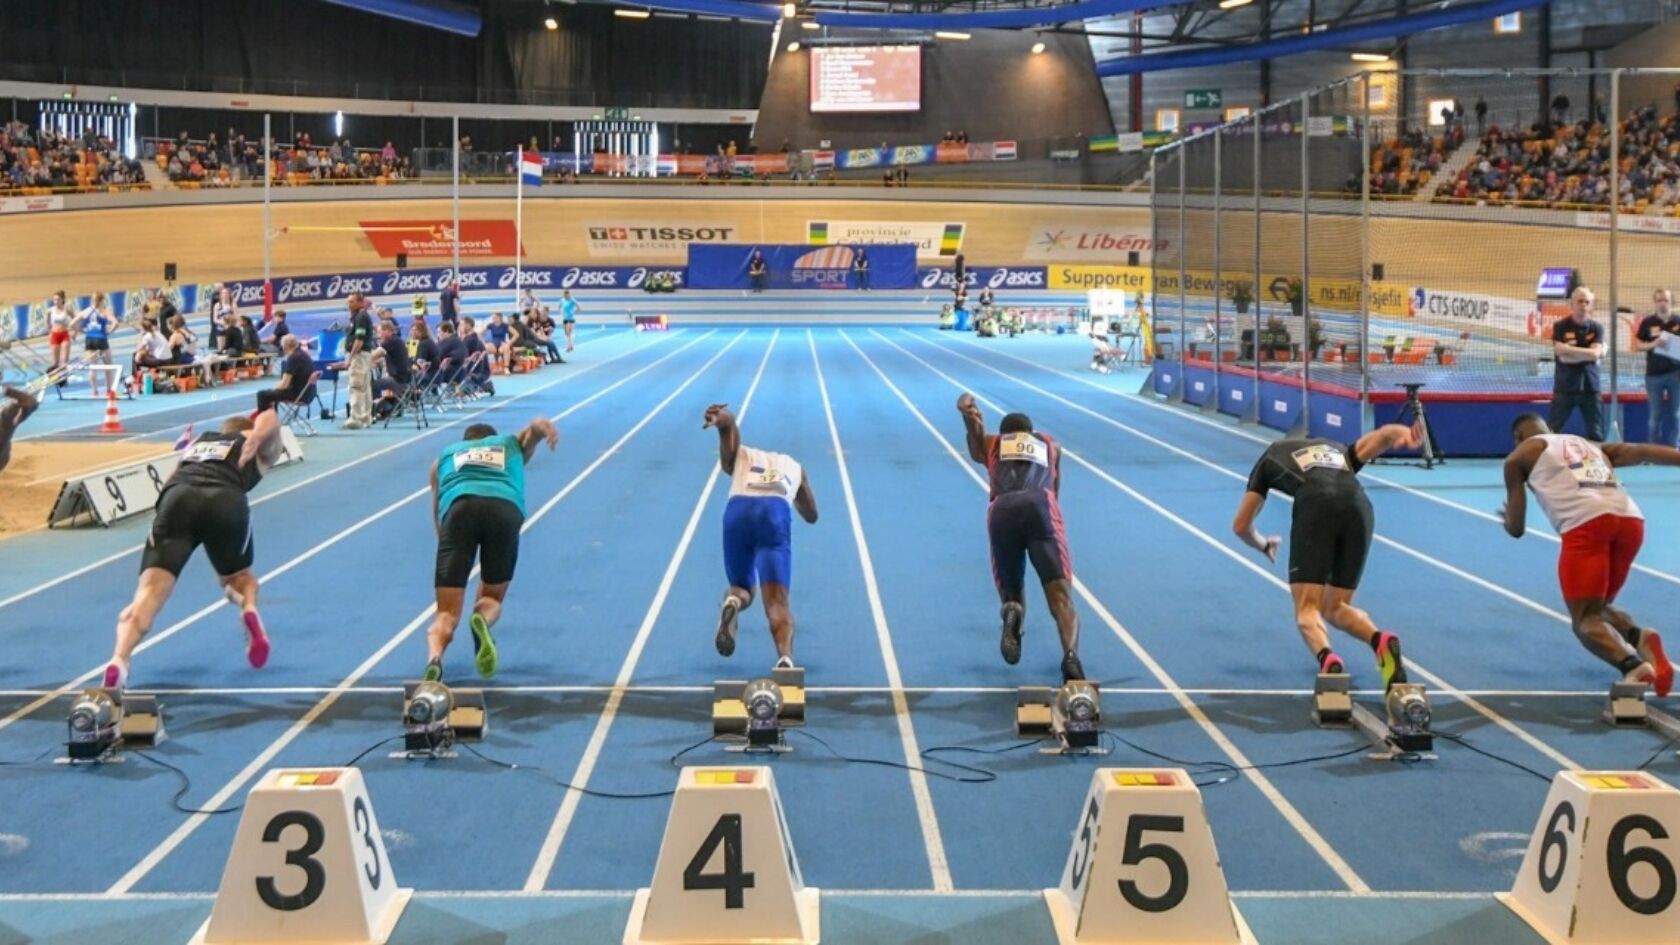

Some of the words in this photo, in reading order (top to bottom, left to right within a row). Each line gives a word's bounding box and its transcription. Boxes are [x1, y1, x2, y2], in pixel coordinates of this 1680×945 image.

[630, 228, 732, 240] TISSOT
[847, 227, 911, 237] provincie
[791, 270, 849, 283] SPORT
[1063, 269, 1145, 288] Supporter
[1321, 284, 1401, 309] ns.nl/risjefit
[1429, 295, 1448, 316] CTS
[1452, 298, 1489, 320] GROUP
[1016, 442, 1034, 454] 90
[105, 476, 126, 511] 9
[354, 795, 381, 890] 3
[1072, 796, 1099, 891] 5
[1538, 800, 1576, 893] 6
[256, 810, 326, 911] 3
[683, 813, 755, 909] 4
[1117, 813, 1189, 913] 5
[1606, 813, 1677, 915] 6
